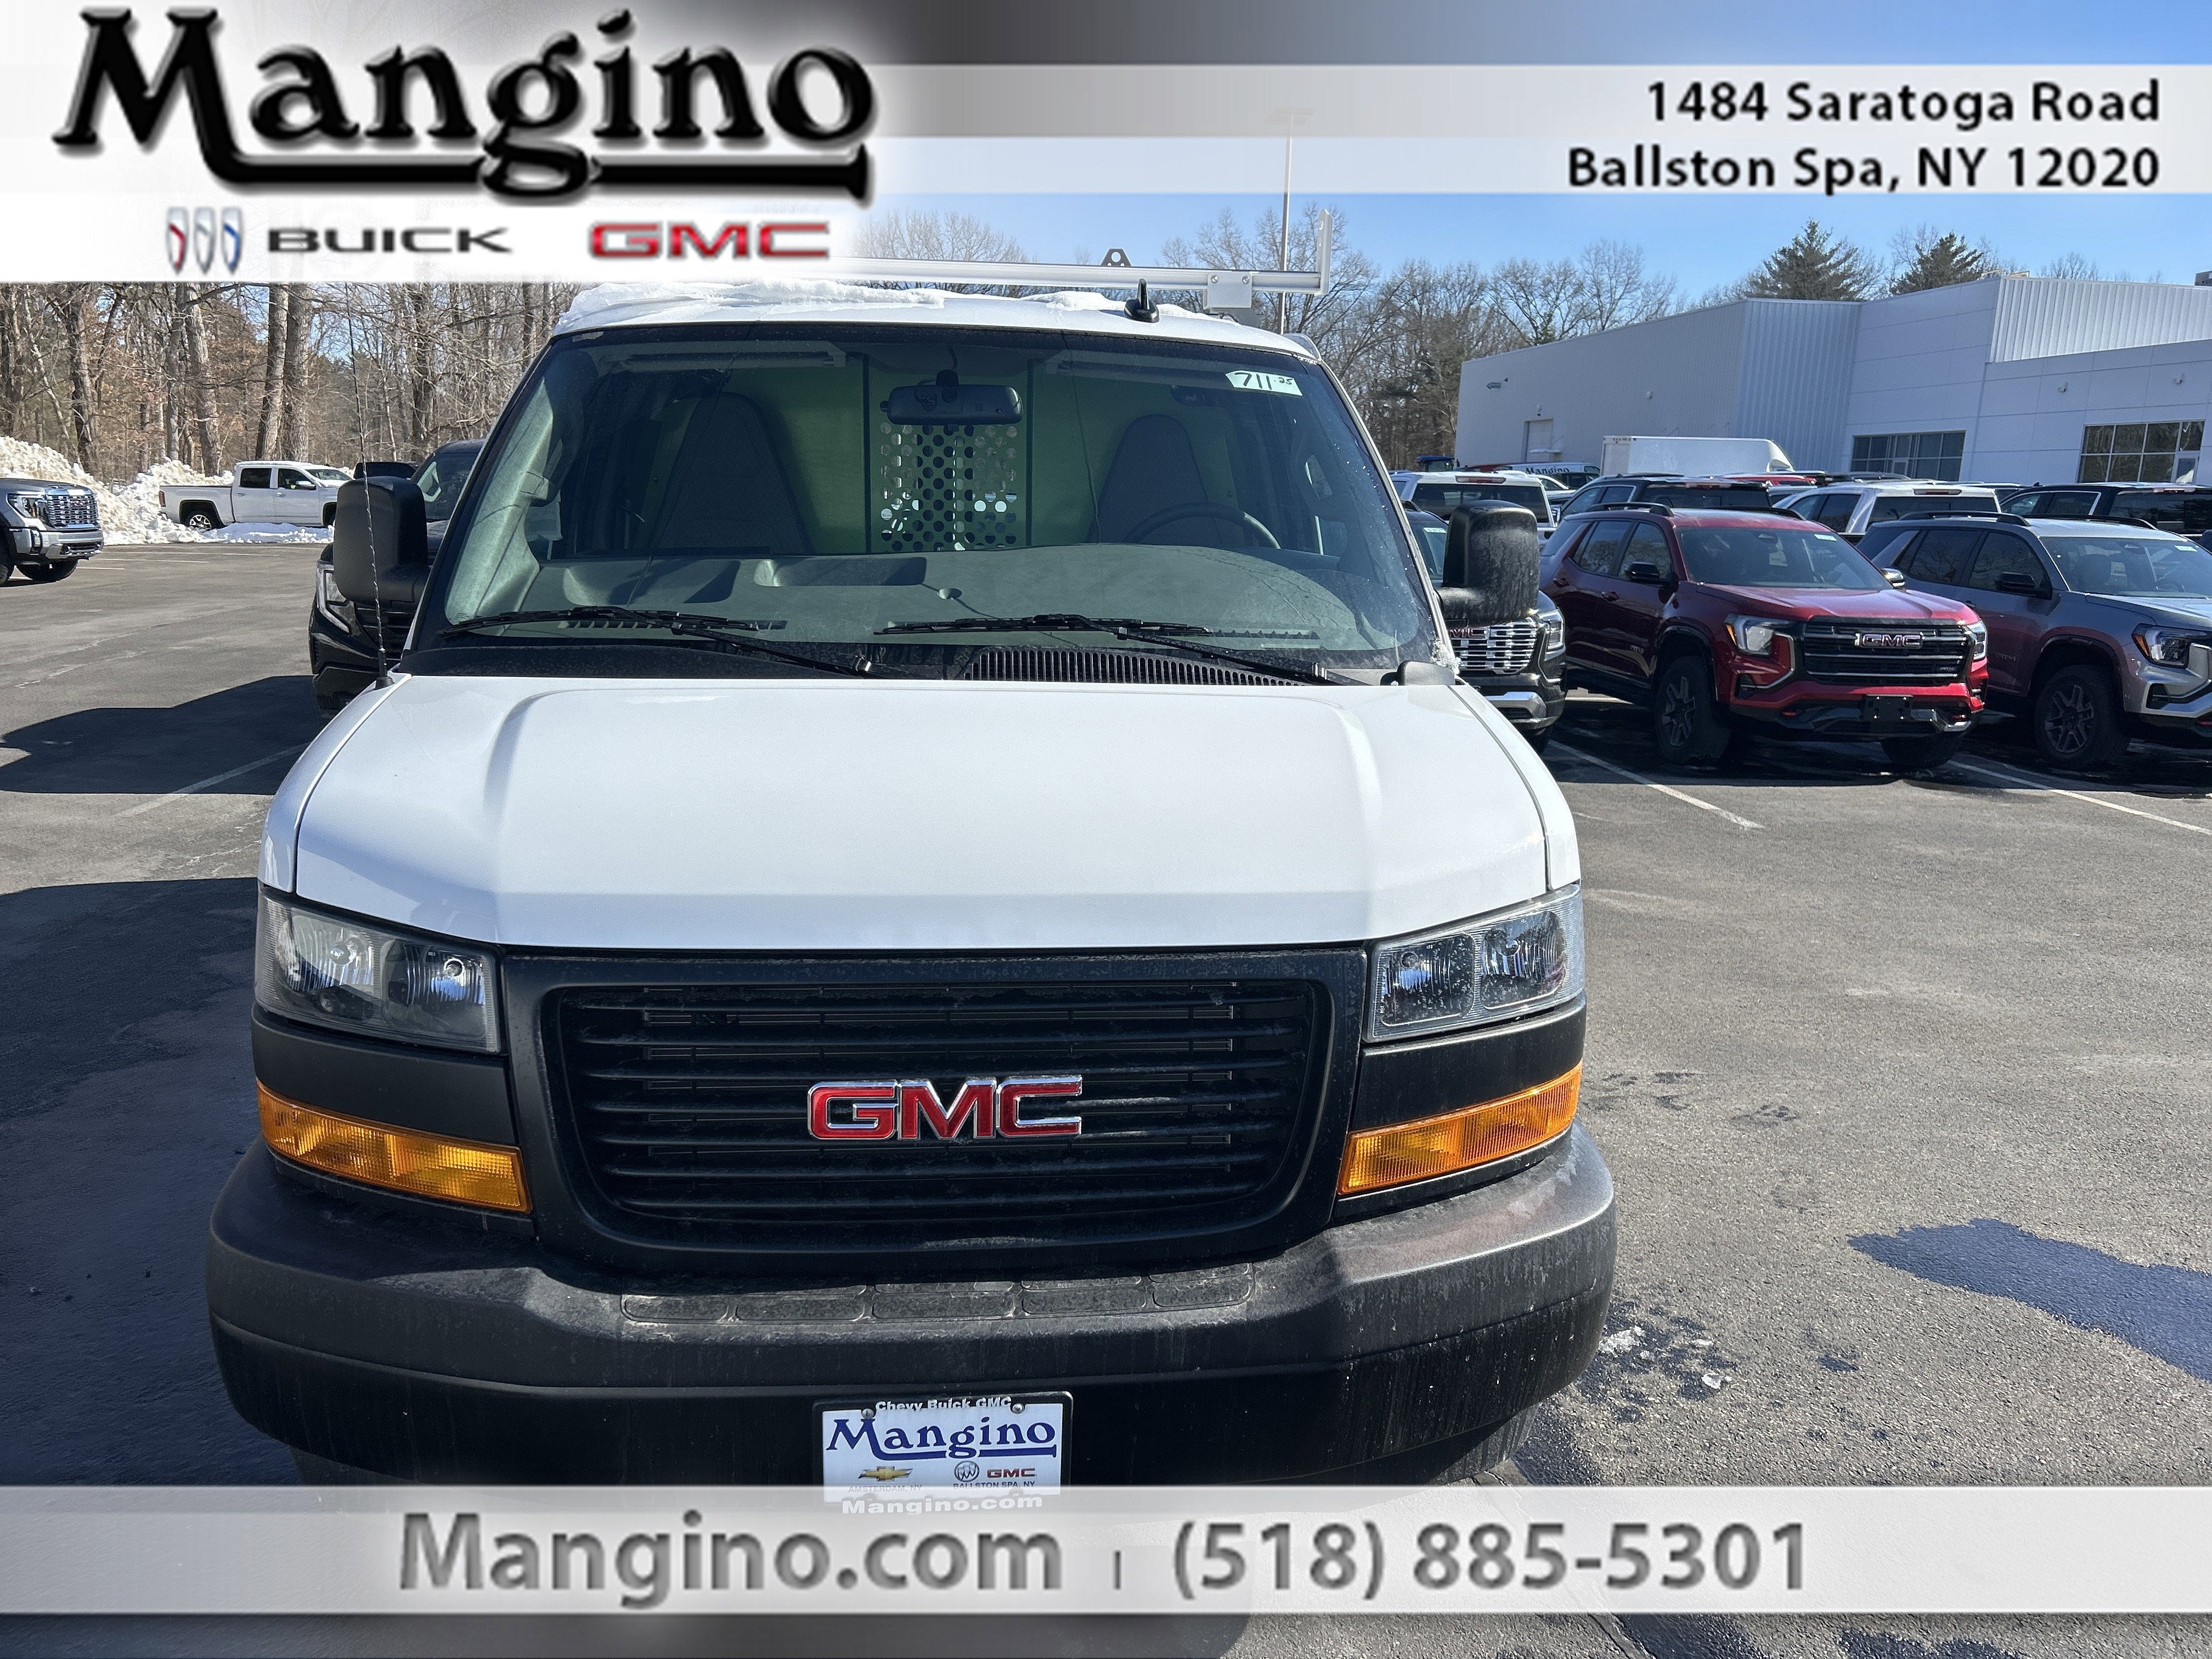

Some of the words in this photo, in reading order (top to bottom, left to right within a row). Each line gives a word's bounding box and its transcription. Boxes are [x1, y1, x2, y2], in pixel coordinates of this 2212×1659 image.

[1862, 634, 1921, 647] GMC
[808, 1074, 1082, 1141] GMC
[875, 1401, 923, 1412] Chevy
[927, 1398, 971, 1410] Buick
[975, 1396, 1012, 1408] GMC
[826, 1416, 1057, 1460] Mangino
[987, 1468, 1036, 1479] GMC
[842, 1496, 1043, 1515] Mangino.com
